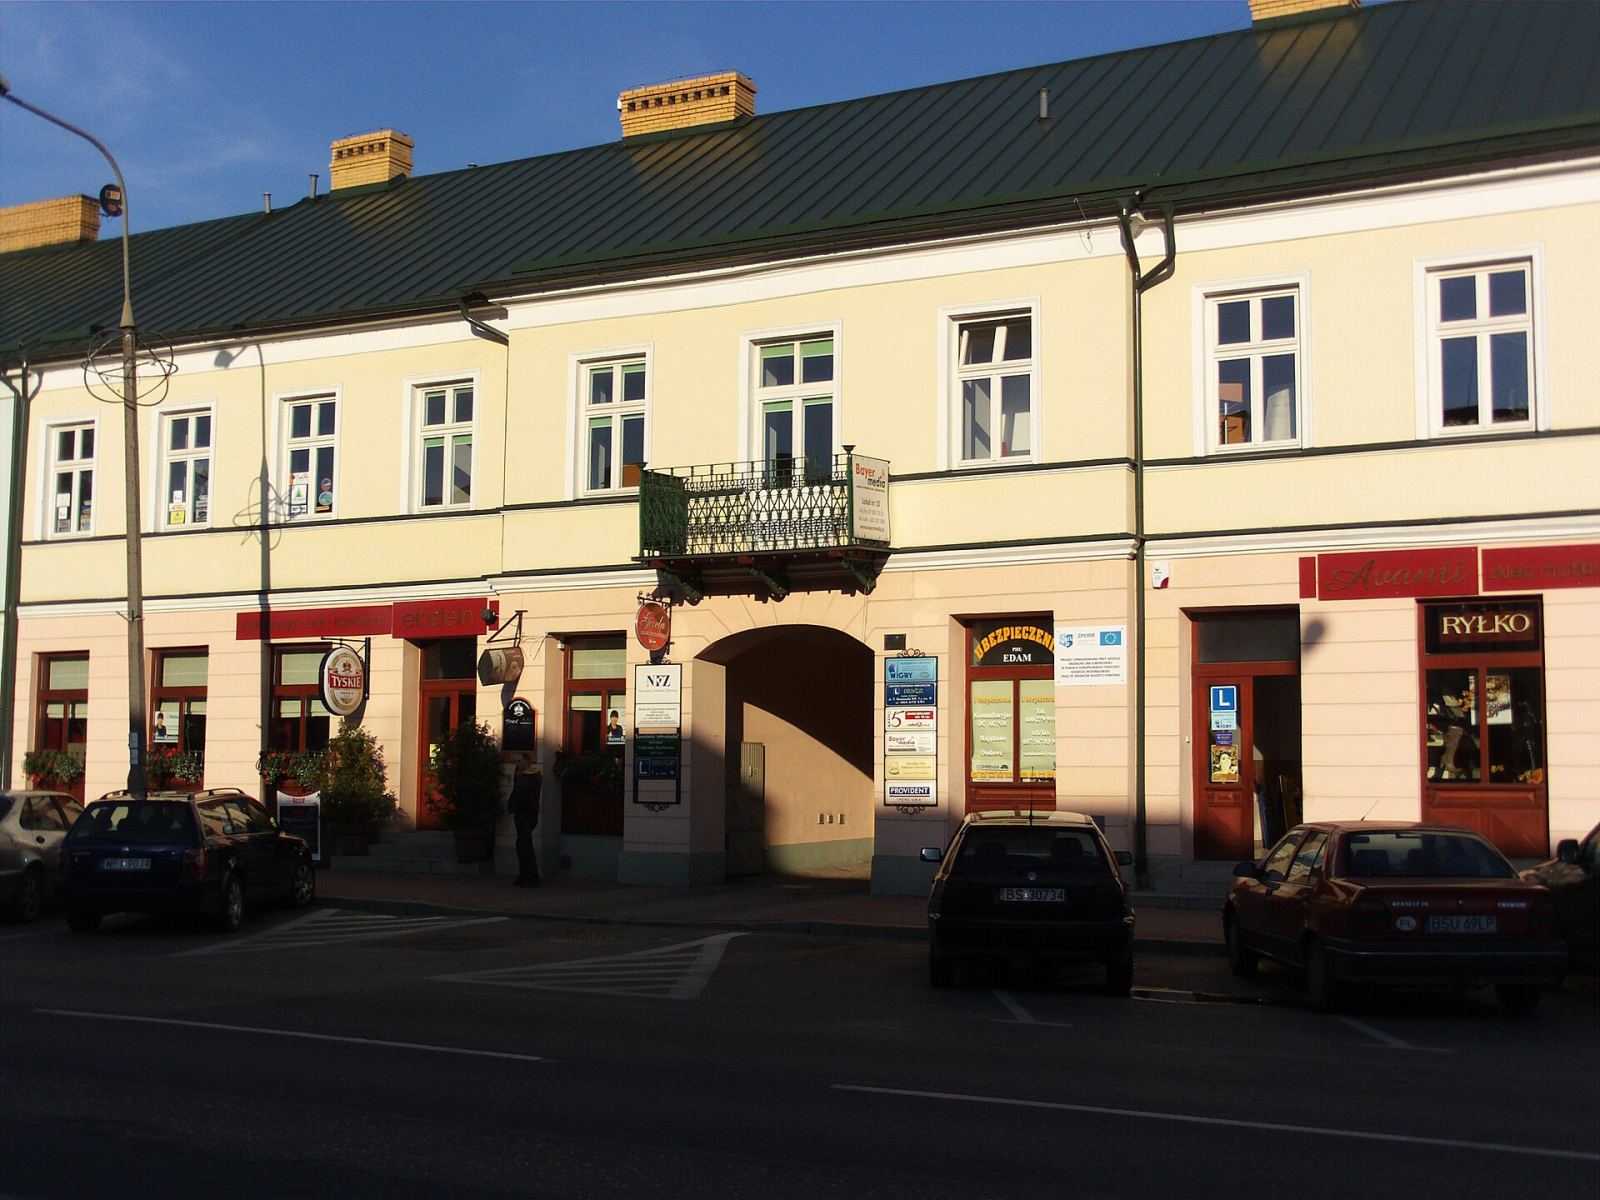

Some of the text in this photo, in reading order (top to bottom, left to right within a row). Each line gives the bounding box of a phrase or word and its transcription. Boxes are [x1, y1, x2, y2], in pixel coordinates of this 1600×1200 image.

[855, 463, 875, 478] Bayer
[867, 477, 885, 488] media
[1325, 559, 1467, 592] Avanti
[403, 607, 475, 629] einstein
[1442, 613, 1530, 635] RYŁKO
[1003, 654, 1032, 662] EDAM
[331, 676, 361, 688] TYSKIE
[1219, 690, 1230, 706] L
[891, 710, 905, 727] 5
[639, 761, 648, 774] L
[1006, 889, 1024, 900] BS
[1400, 919, 1414, 928] PL
[1430, 917, 1495, 930] BSU 69LP
